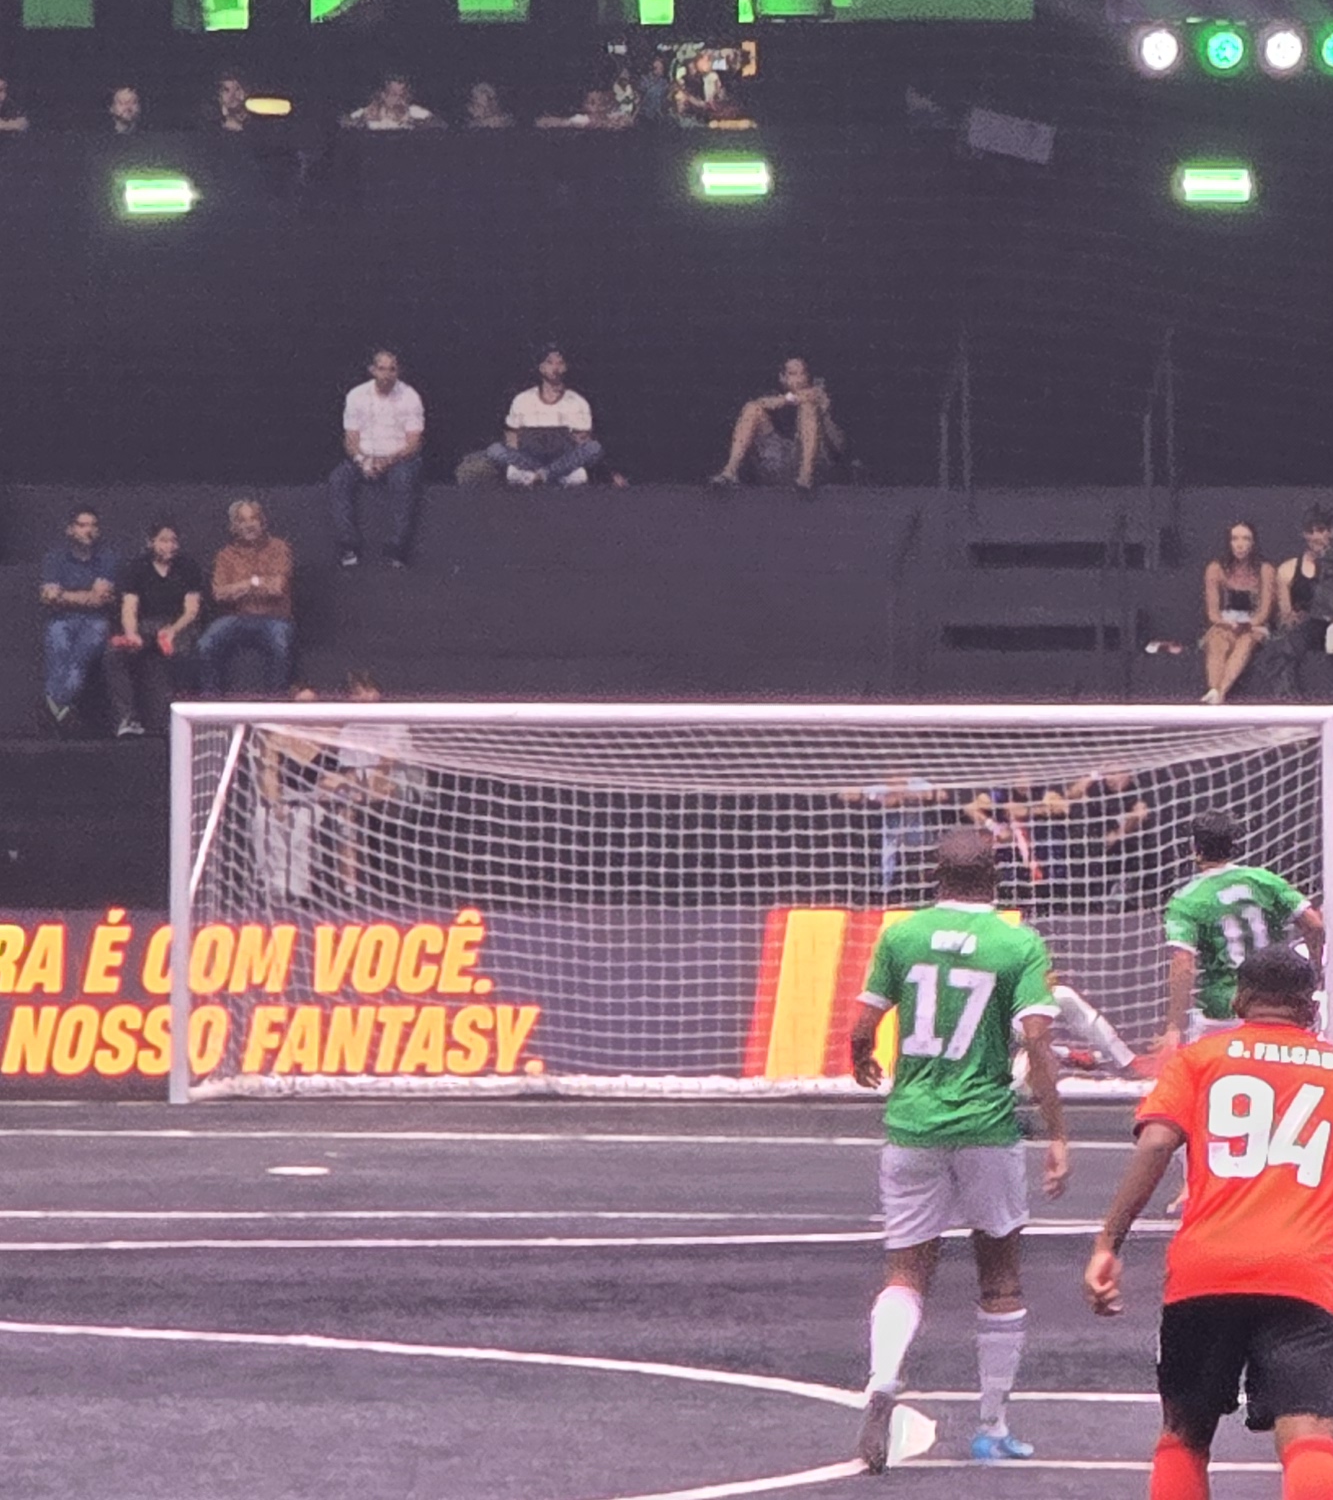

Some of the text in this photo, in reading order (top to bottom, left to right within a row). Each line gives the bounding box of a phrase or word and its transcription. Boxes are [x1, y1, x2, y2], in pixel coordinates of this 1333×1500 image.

[83, 908, 131, 994] É
[142, 924, 295, 995] COM
[314, 908, 494, 995] VOCÊ.
[2, 1005, 544, 1076] NOSSO FANTASY.
[902, 964, 998, 1062] 17
[1208, 1073, 1332, 1188] 94
